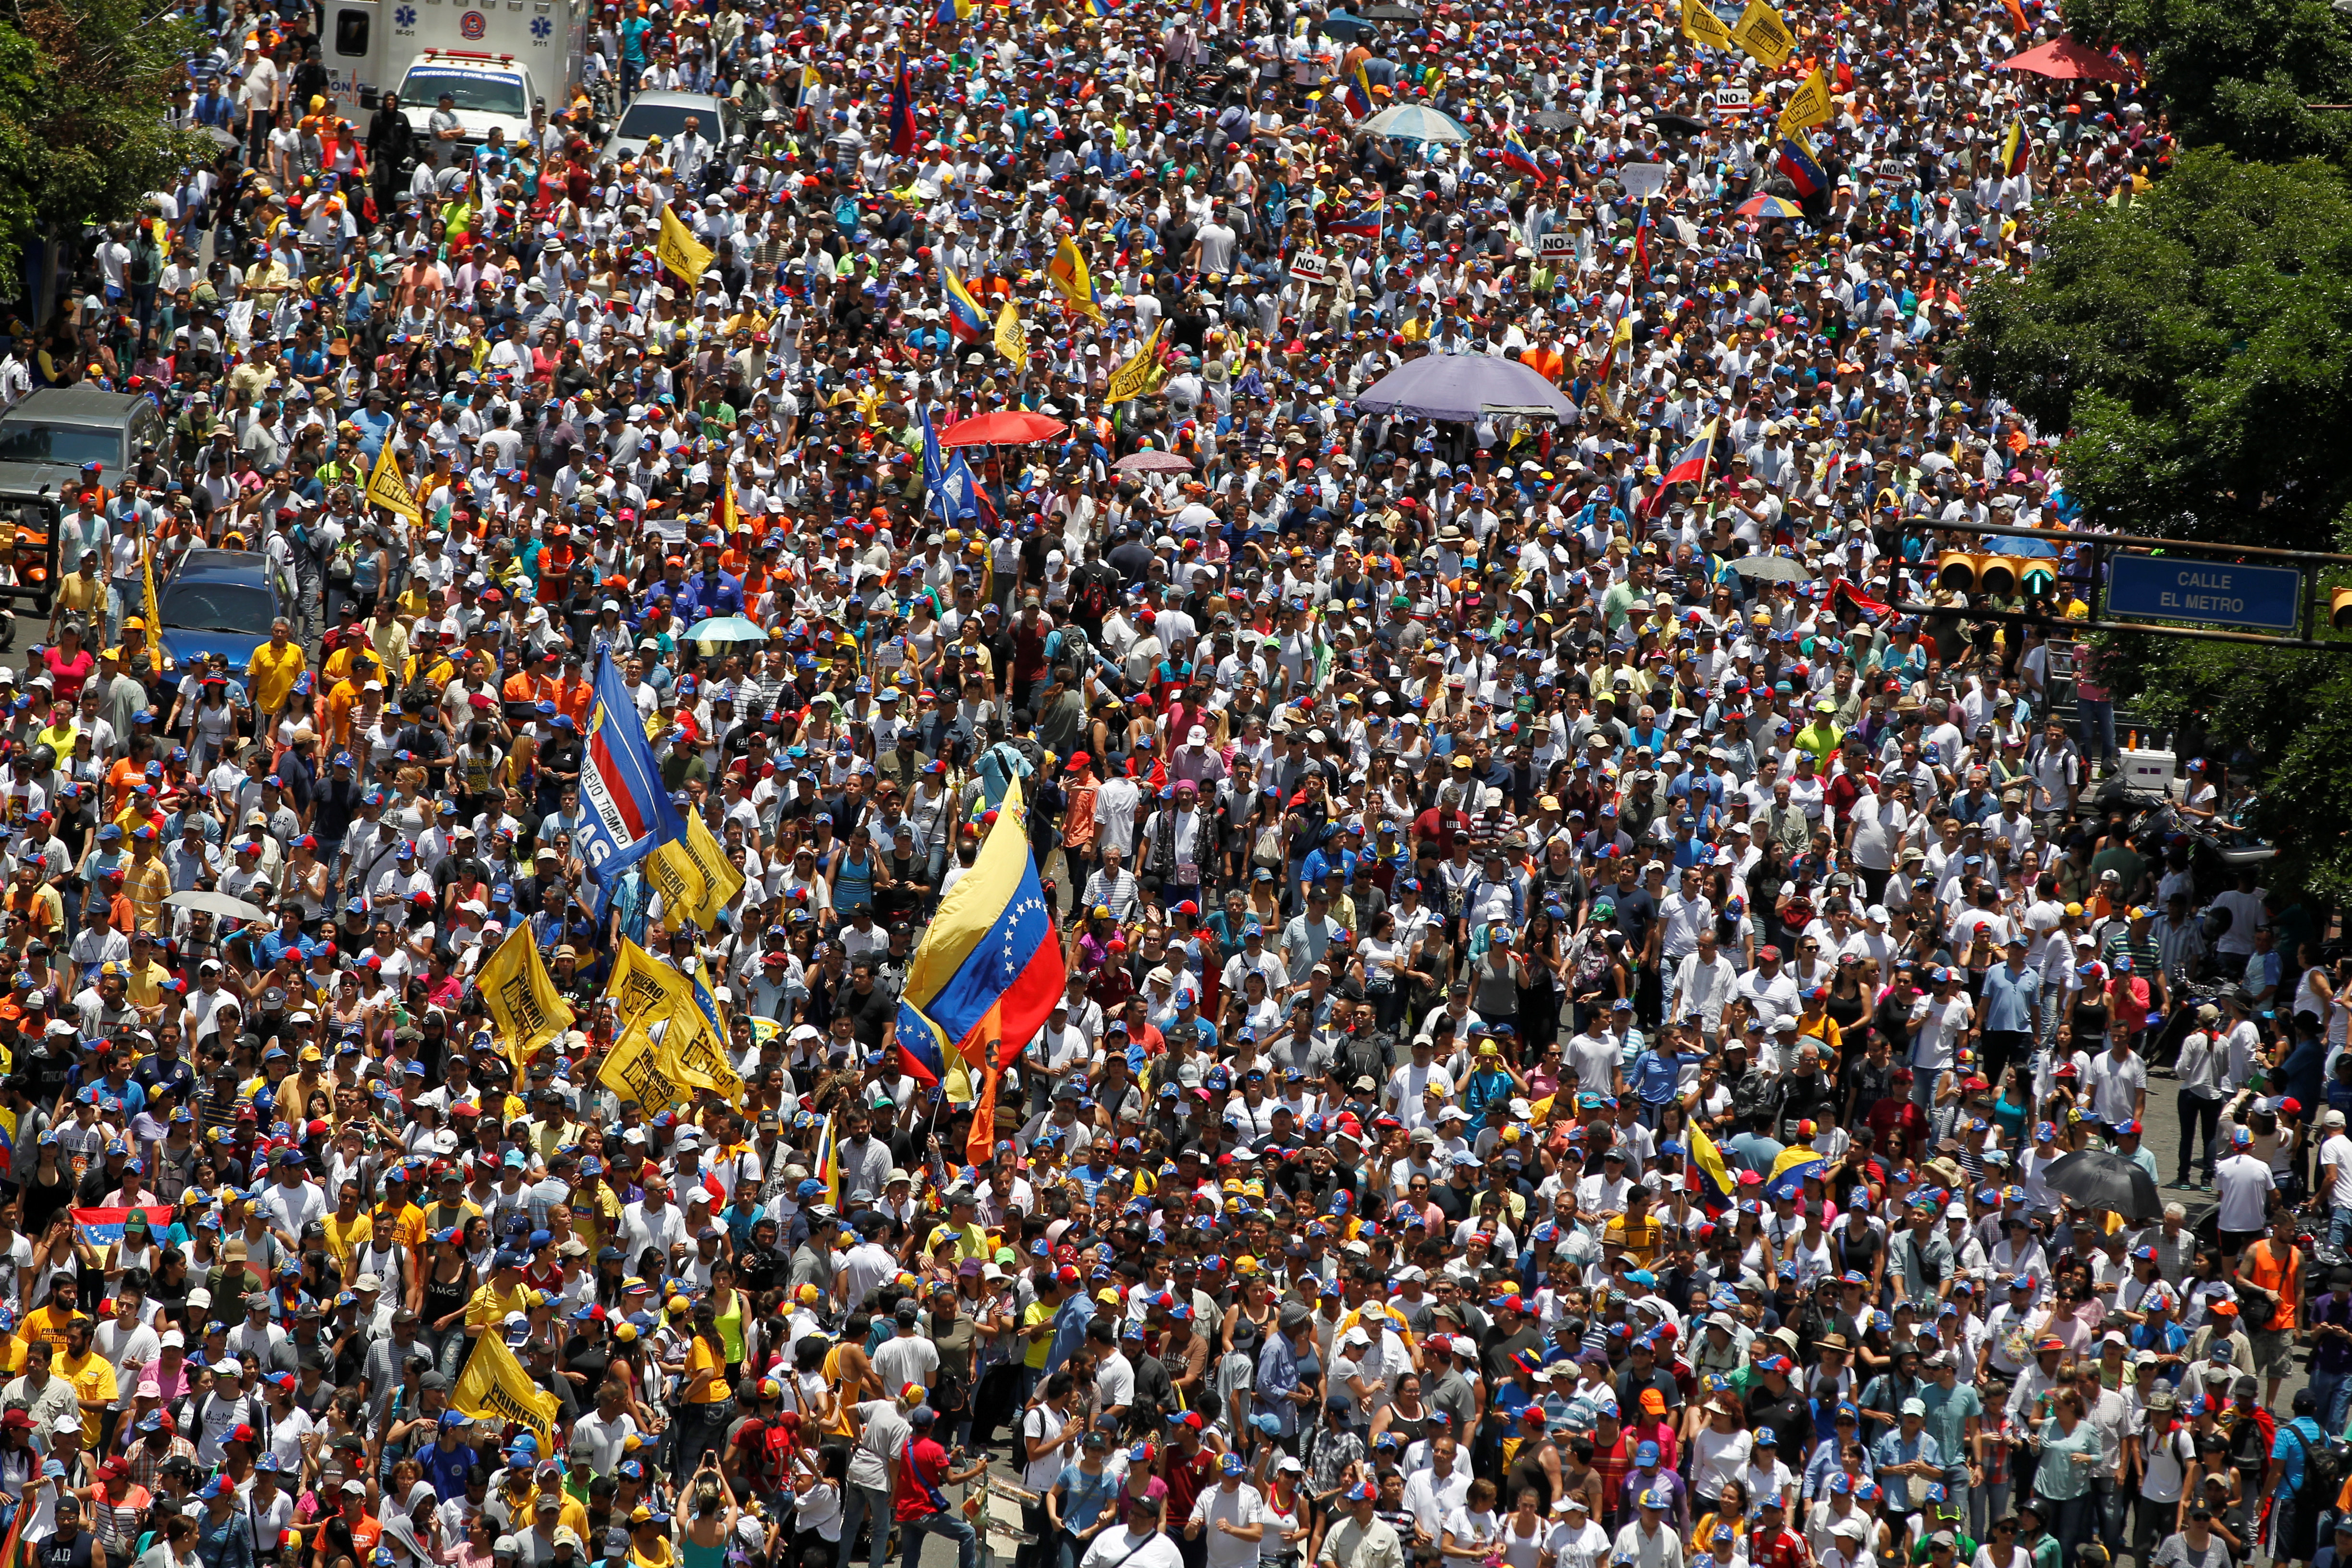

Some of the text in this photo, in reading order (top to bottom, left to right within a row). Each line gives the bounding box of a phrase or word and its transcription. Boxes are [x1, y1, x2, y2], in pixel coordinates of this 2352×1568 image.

[1759, 18, 1785, 44] PRIMERO
[1745, 26, 1778, 56] JUSTICIA
[485, 74, 520, 86] MIRANDA
[1720, 93, 1746, 104] NO+
[1883, 163, 1903, 175] NO+
[1544, 238, 1574, 250] NO+
[1296, 256, 1323, 271] NO+
[2178, 572, 2231, 590] CALLE
[2161, 592, 2244, 613] EL METRO
[598, 799, 628, 845] TIEMPO
[1447, 821, 1461, 829] LEVEL
[629, 968, 665, 1000] PRIMERO
[65, 1138, 98, 1150] SUNSET
[429, 1285, 463, 1297] OMG!
[491, 1386, 547, 1433] PRIMERO
[52, 1548, 71, 1562] AD
